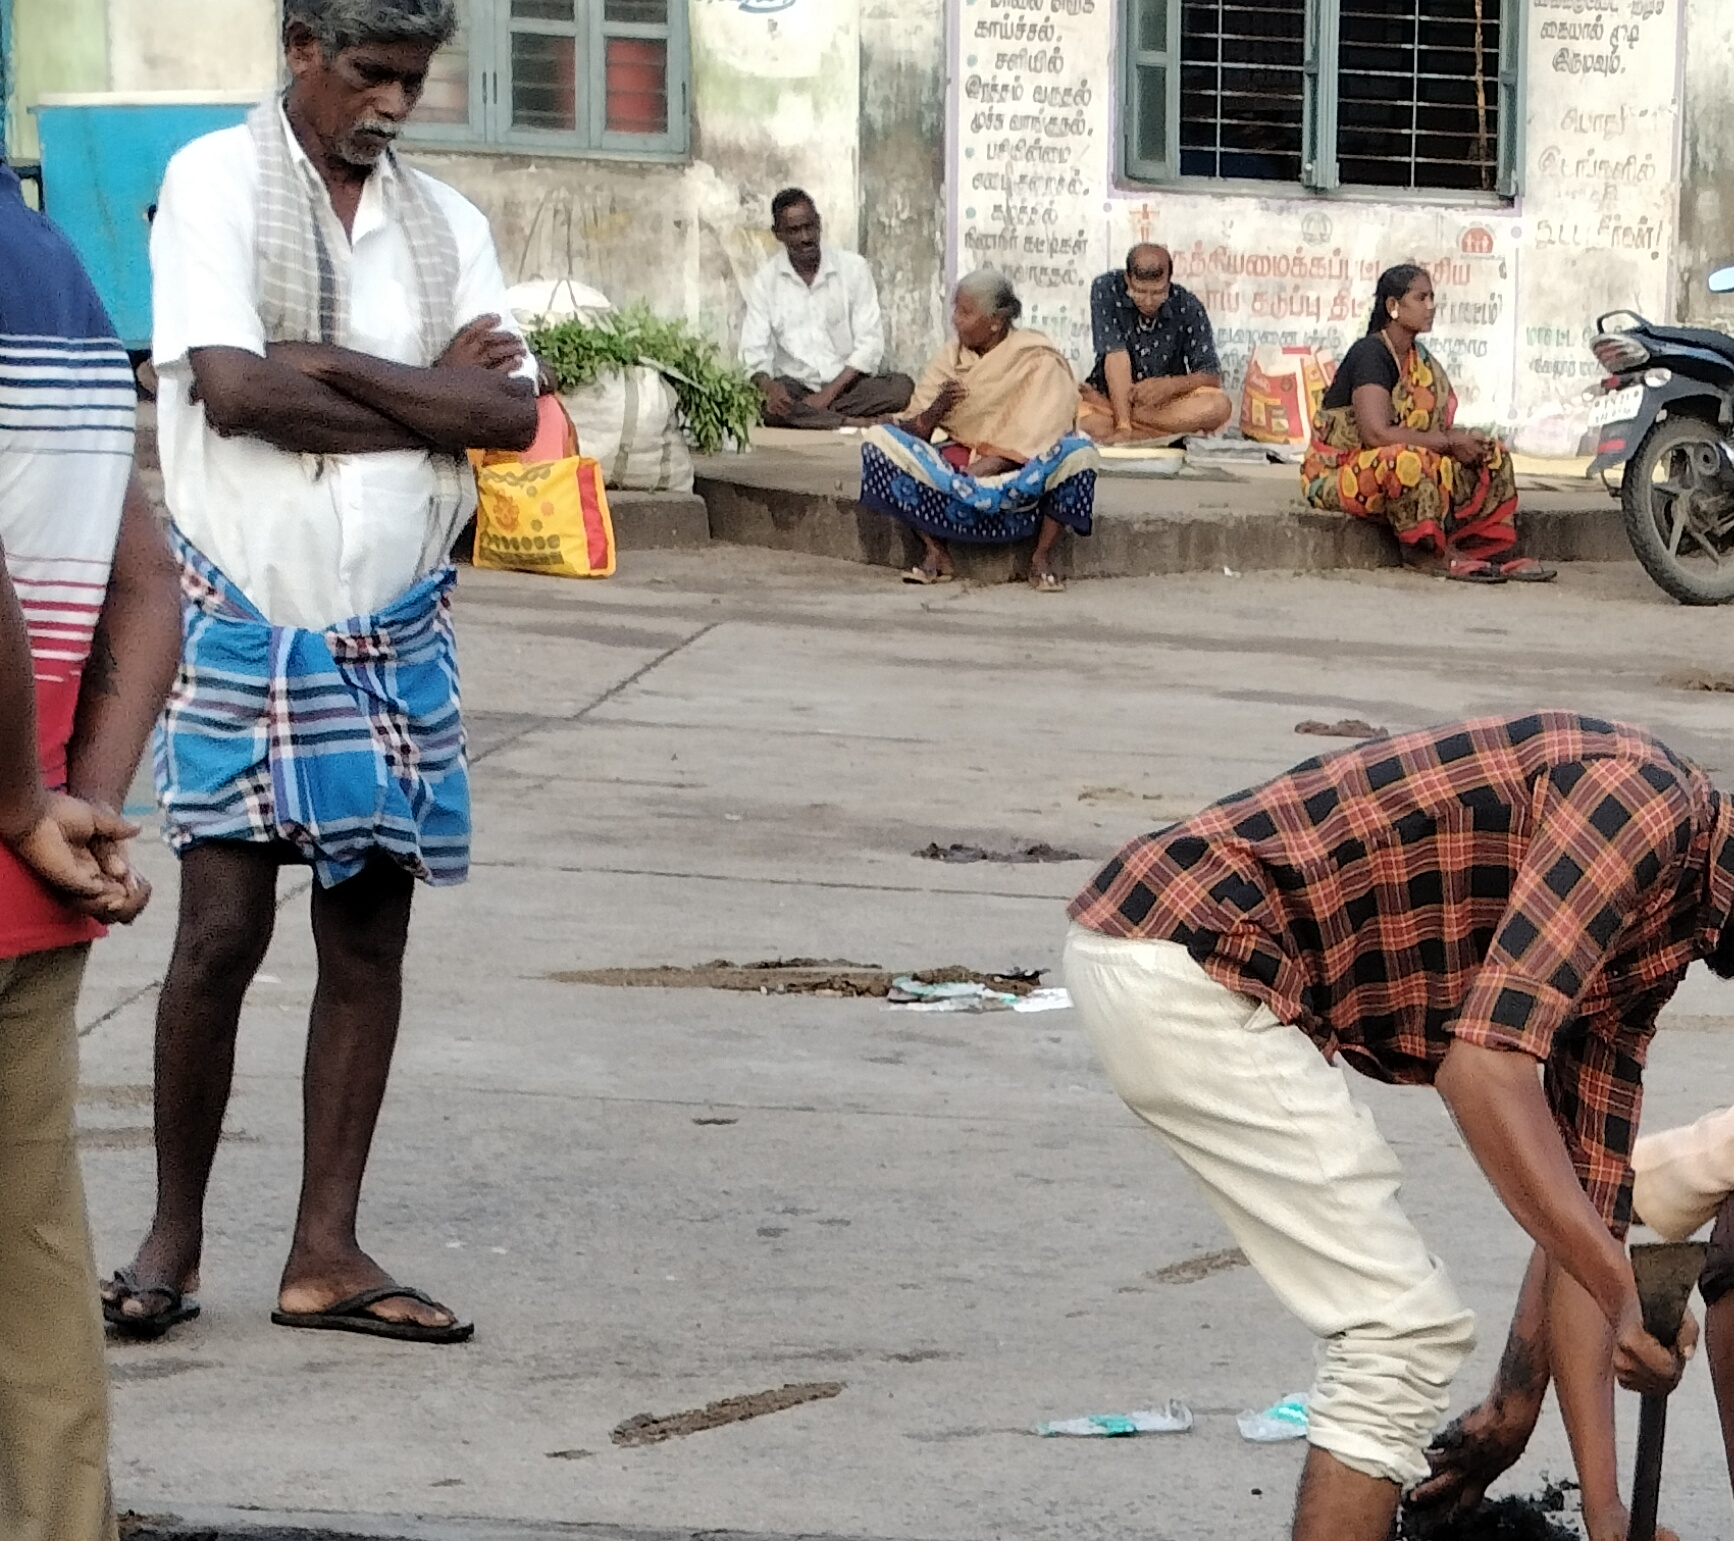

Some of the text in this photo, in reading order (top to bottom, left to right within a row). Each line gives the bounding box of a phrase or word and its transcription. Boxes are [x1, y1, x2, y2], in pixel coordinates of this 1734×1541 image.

[974, 12, 1063, 43] காய்ச்சல்.
[1540, 14, 1604, 41] கையால்
[995, 46, 1064, 74] சளியில்
[965, 74, 1092, 108] இரத்தம் வருதல்
[986, 137, 1072, 164] பசியின்மை
